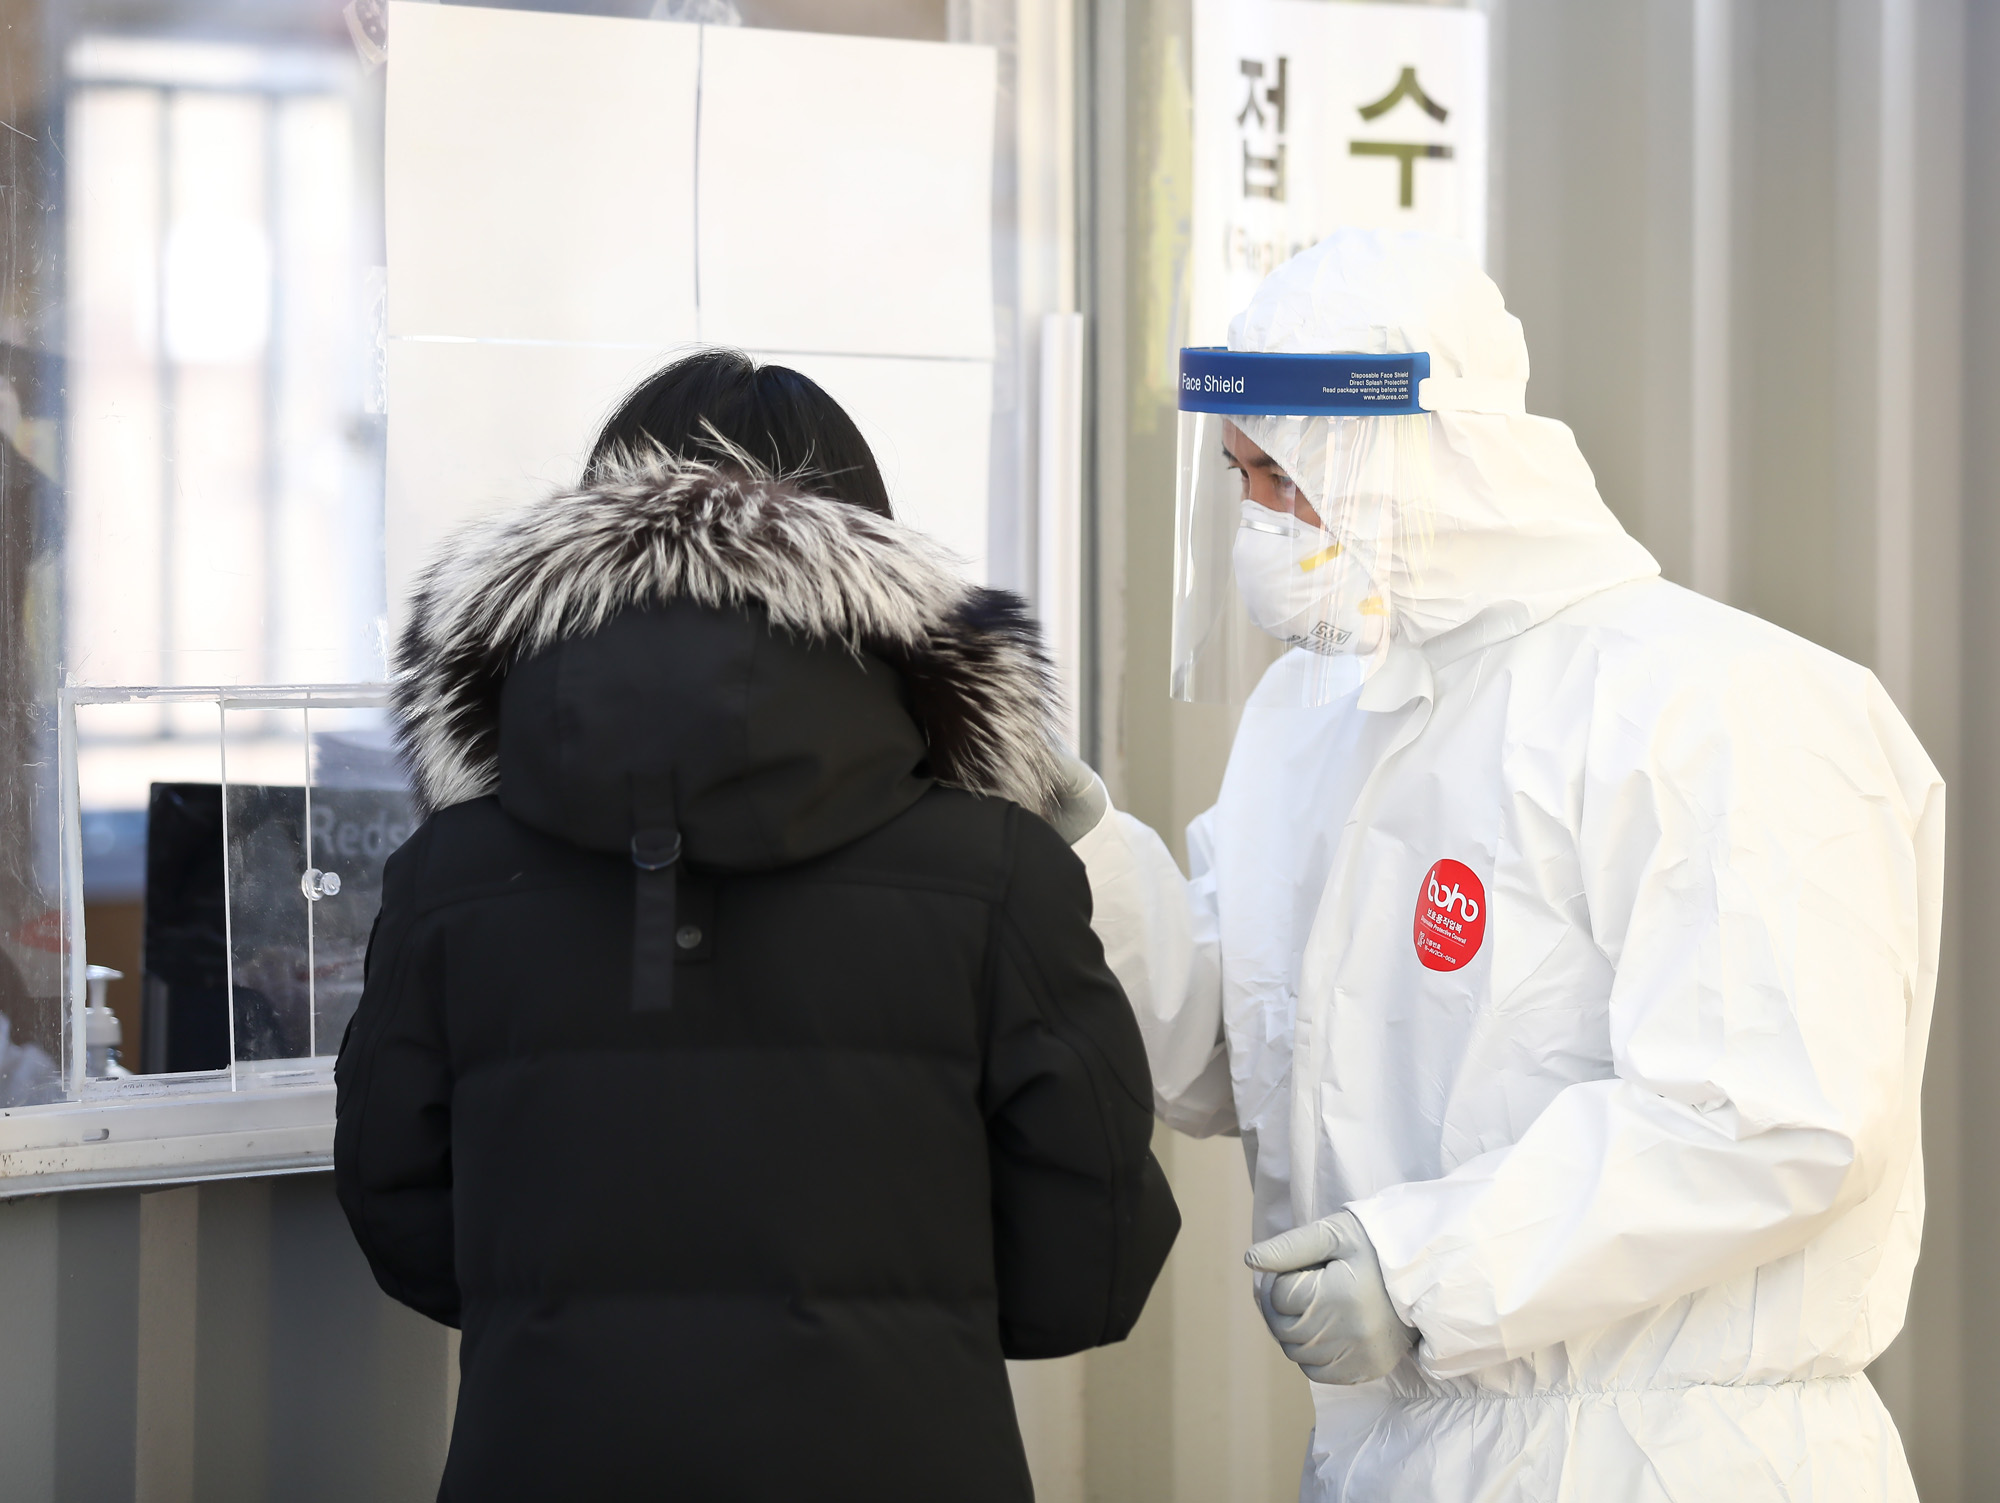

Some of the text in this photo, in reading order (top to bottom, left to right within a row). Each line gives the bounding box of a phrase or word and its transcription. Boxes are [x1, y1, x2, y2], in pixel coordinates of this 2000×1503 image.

[1237, 56, 1454, 209] 접 수
[1182, 372, 1245, 394] Face Shield
[1365, 379, 1383, 387] Splash
[1380, 371, 1393, 379] Face
[1428, 870, 1479, 922] boho
